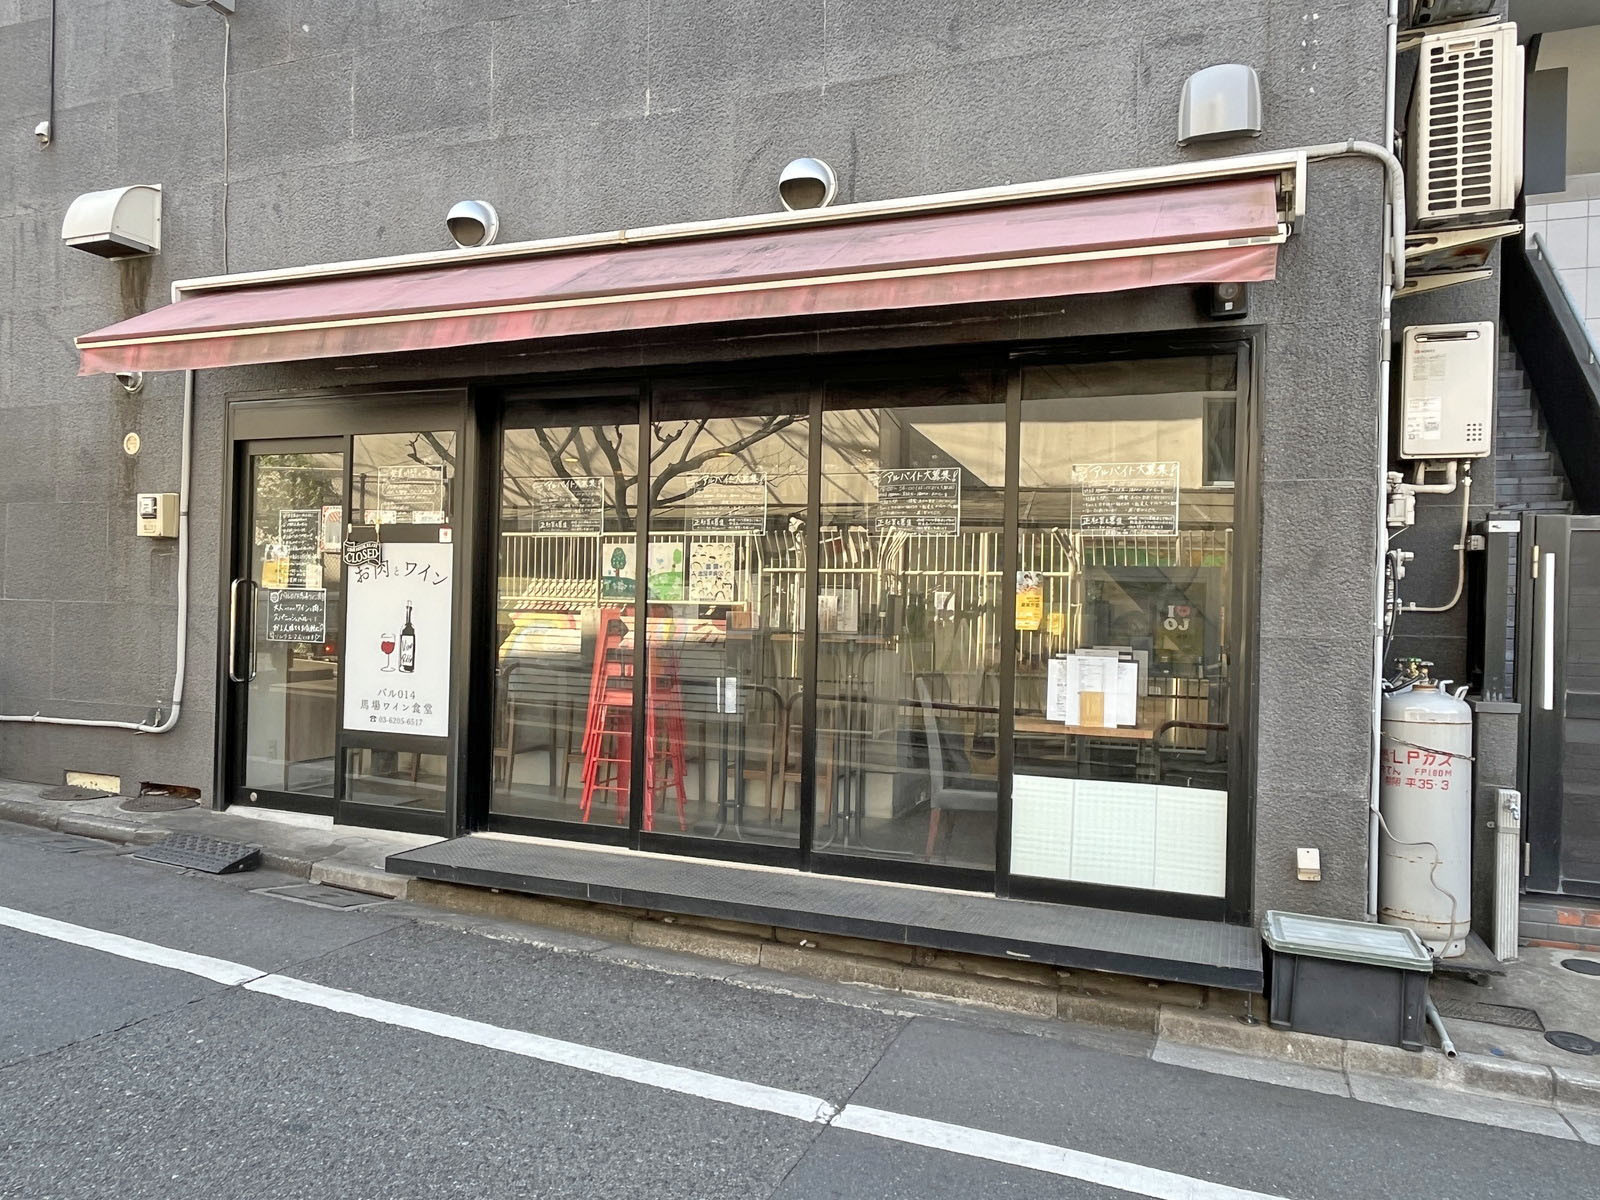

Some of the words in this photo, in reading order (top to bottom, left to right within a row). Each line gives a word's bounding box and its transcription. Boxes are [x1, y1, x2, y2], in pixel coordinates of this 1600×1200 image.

[345, 548, 378, 563] CLOSED
[354, 559, 449, 586] お肉とワイン
[1163, 618, 1190, 631] OJ
[377, 688, 416, 700] バル014
[360, 699, 433, 715] 馬場ワイン食堂
